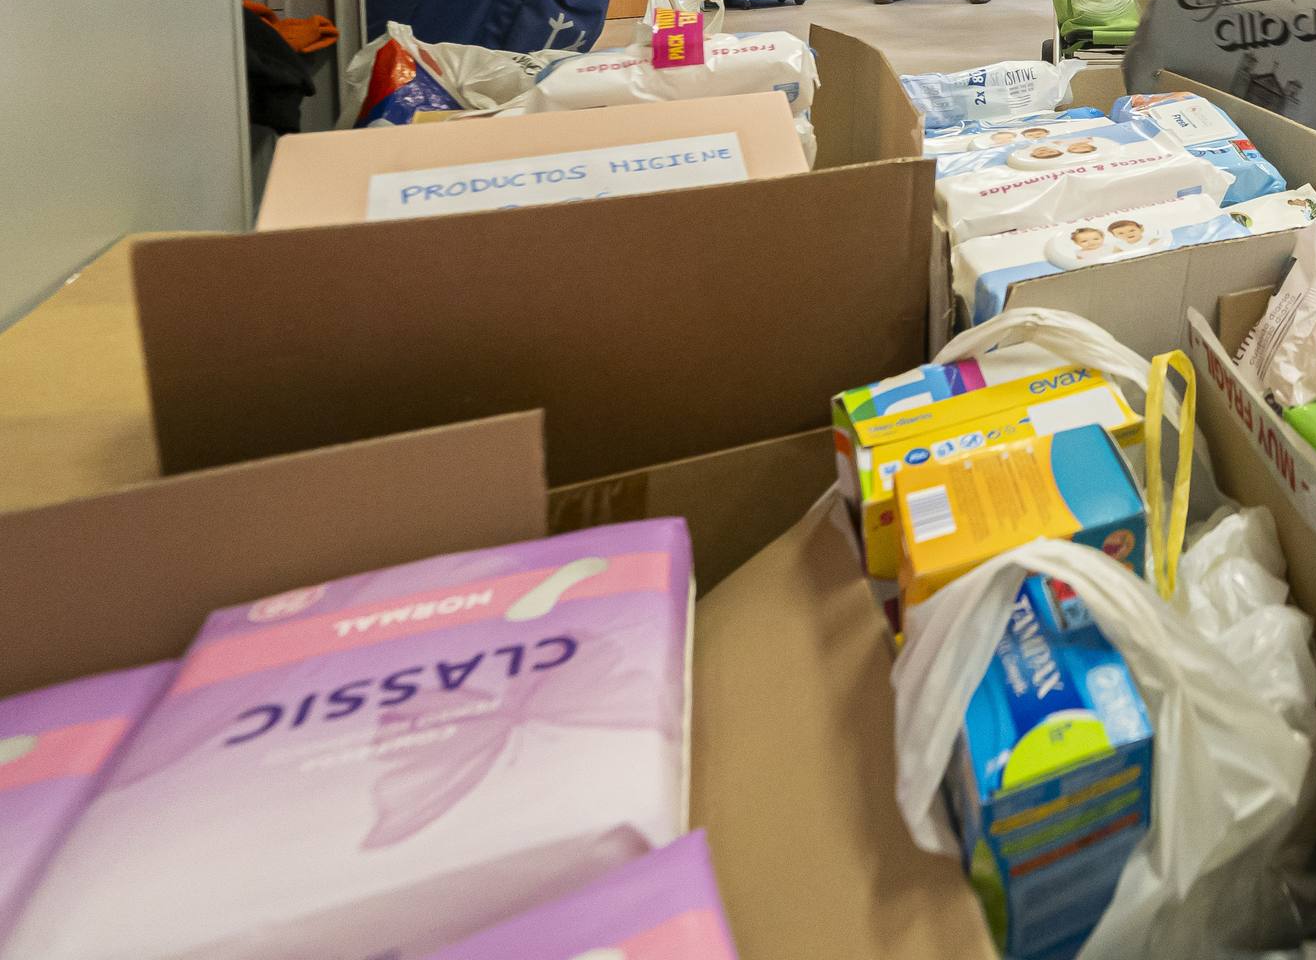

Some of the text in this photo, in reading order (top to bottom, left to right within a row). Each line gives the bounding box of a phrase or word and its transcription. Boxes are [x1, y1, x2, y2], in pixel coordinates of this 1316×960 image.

[668, 34, 685, 60] PACK
[399, 165, 588, 206] PRODUCTOS
[608, 147, 733, 175] HIGIENE
[978, 165, 1088, 199] perfumadas
[1028, 367, 1092, 395] evax
[1257, 414, 1296, 493] MUY
[334, 589, 494, 638] NORMAL
[224, 635, 579, 747] CLASSIC
